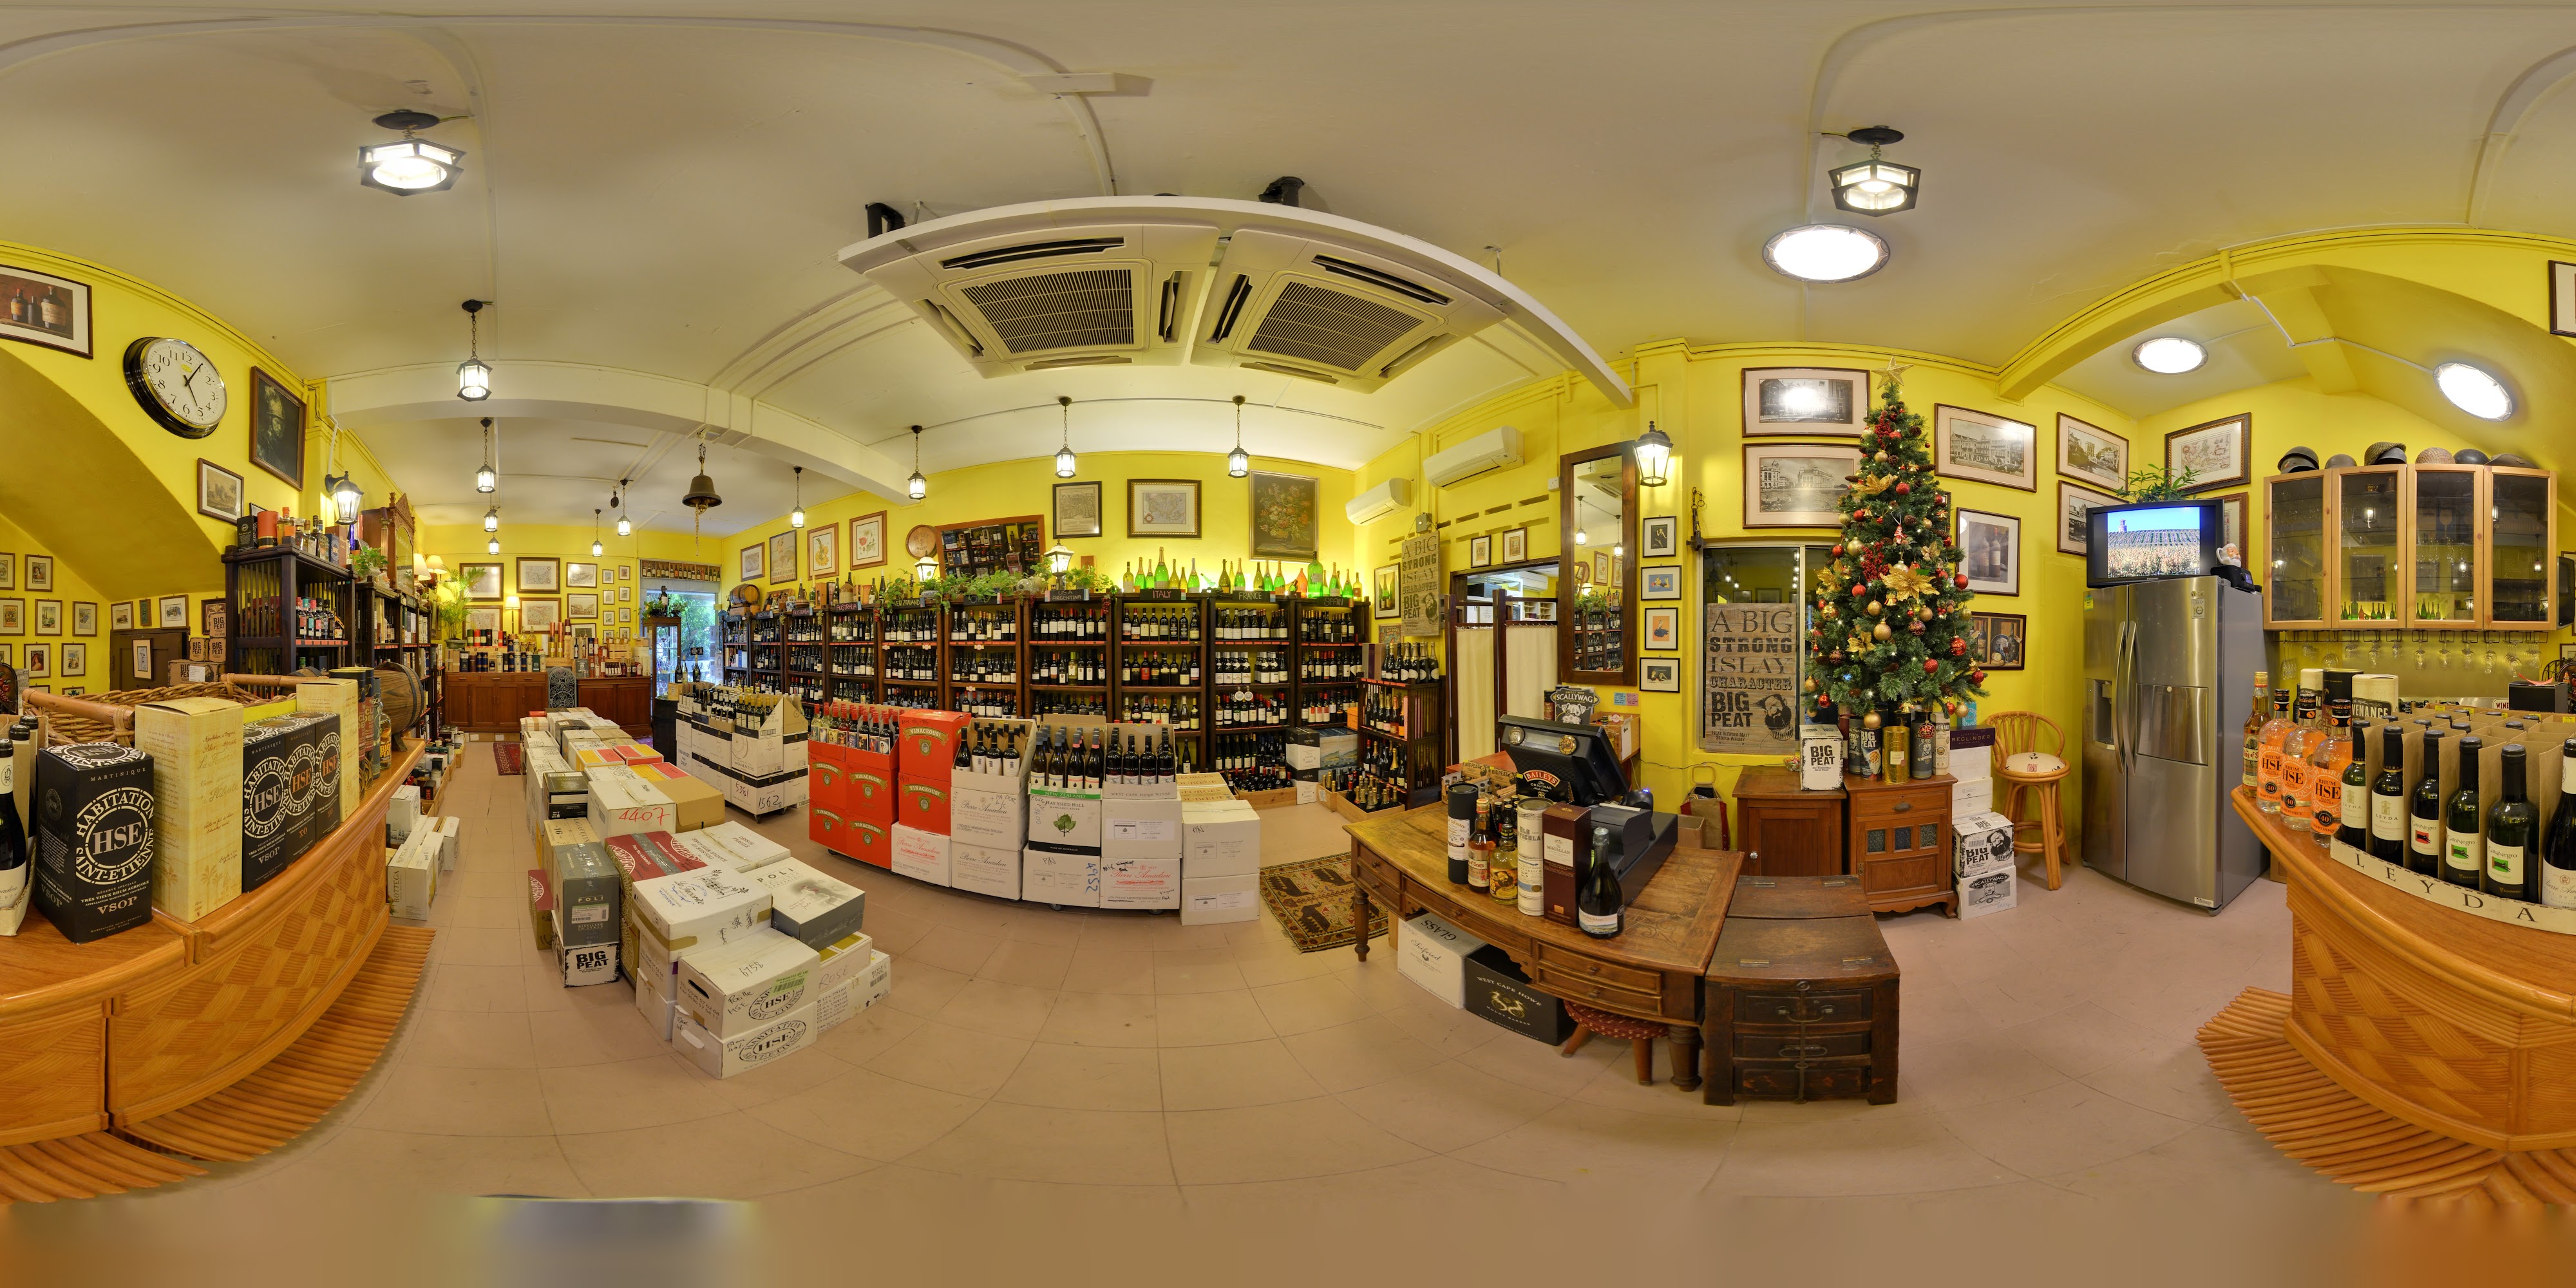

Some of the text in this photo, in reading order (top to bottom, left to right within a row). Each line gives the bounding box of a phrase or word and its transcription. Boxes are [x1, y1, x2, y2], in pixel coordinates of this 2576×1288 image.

[158, 354, 171, 366] 10
[169, 350, 178, 361] 11
[182, 352, 193, 365] 12
[153, 363, 161, 374] 9
[158, 379, 166, 390] 8
[205, 376, 211, 386] 2
[171, 393, 177, 404] 7
[211, 392, 216, 401] 3
[183, 404, 190, 414] 6
[198, 407, 204, 417] 5
[205, 402, 212, 411] 4
[1403, 536, 1437, 559] A BIG
[1402, 554, 1437, 571] STRONG
[1403, 566, 1437, 584] ISLAY
[1403, 582, 1437, 594] CHARACTER
[1239, 592, 1262, 600] FRANCE
[1323, 598, 1343, 607] SPAIN
[1403, 593, 1419, 610] BIG
[1404, 607, 1421, 620] PEAT
[1710, 609, 1793, 634] A BIG
[1709, 637, 1792, 653] STRONG
[1710, 656, 1793, 674] ISLAY
[1709, 676, 1792, 690] CHARACTER
[1557, 694, 1593, 703] SCALLYWAG
[1711, 692, 1750, 712] BIG
[1711, 712, 1753, 728] PEAT
[910, 728, 942, 737] VINACEOUS!
[1861, 731, 1875, 741] BIG
[251, 741, 281, 755] MARTINIQUE
[1810, 745, 1833, 757] BIG
[323, 754, 337, 777] HSE
[735, 762, 754, 772] MOMENTOS
[817, 763, 838, 773] VINACEOUS!
[1811, 757, 1835, 766] PEAT
[90, 767, 146, 782] MARTINIQUE
[292, 768, 312, 793] HSE
[855, 774, 881, 783] VINACEOUS!
[1527, 772, 1558, 784] BAILEYS
[2283, 769, 2304, 784] HSE
[735, 781, 749, 797] 5381
[909, 786, 940, 796] VINACEOUS!
[2315, 782, 2341, 799] HSE
[254, 784, 281, 814] HSE
[758, 795, 781, 809] 1562
[77, 791, 154, 837] HABITATION
[960, 800, 978, 810] Pierre
[979, 803, 1007, 815] Amadieu
[619, 807, 670, 826] 4407
[817, 810, 839, 820] VINACEOUS!
[855, 822, 881, 833] VINACEOUS!
[2412, 820, 2437, 831] GatoNegro
[92, 821, 142, 856] HSE
[299, 828, 307, 838] XO
[2447, 834, 2476, 846] GatoNegro
[896, 837, 941, 856] Pierre Amadieu
[1547, 845, 1570, 855] MACALLAN
[2488, 846, 2517, 859] GatoNegro
[258, 846, 279, 864] VSOP
[960, 852, 976, 862] Pierre
[978, 857, 1007, 867] Amadieu
[1966, 853, 1990, 865] PEAT
[757, 868, 793, 883] POLI
[1085, 862, 1100, 894] 4952
[1135, 869, 1171, 878] Amadieu
[128, 880, 149, 891] AGRICOLE
[1975, 876, 2004, 887] SCALLYWAG
[2544, 877, 2559, 891] Pierre
[41, 884, 62, 907] VSOP
[684, 886, 705, 905] Favorite
[97, 896, 137, 914] VSOP
[1421, 920, 1457, 941] GLASS
[576, 951, 607, 963] BIG
[1411, 939, 1441, 961] Seifried
[576, 958, 609, 969] PEAT
[739, 961, 764, 978] 6758
[1477, 976, 1542, 1007] WEST CAPE HOWE
[765, 991, 791, 1009] HSE
[1486, 1006, 1531, 1025] MOUNT BARKER
[744, 1022, 802, 1050] HABITATION
[757, 1031, 791, 1052] HSE
